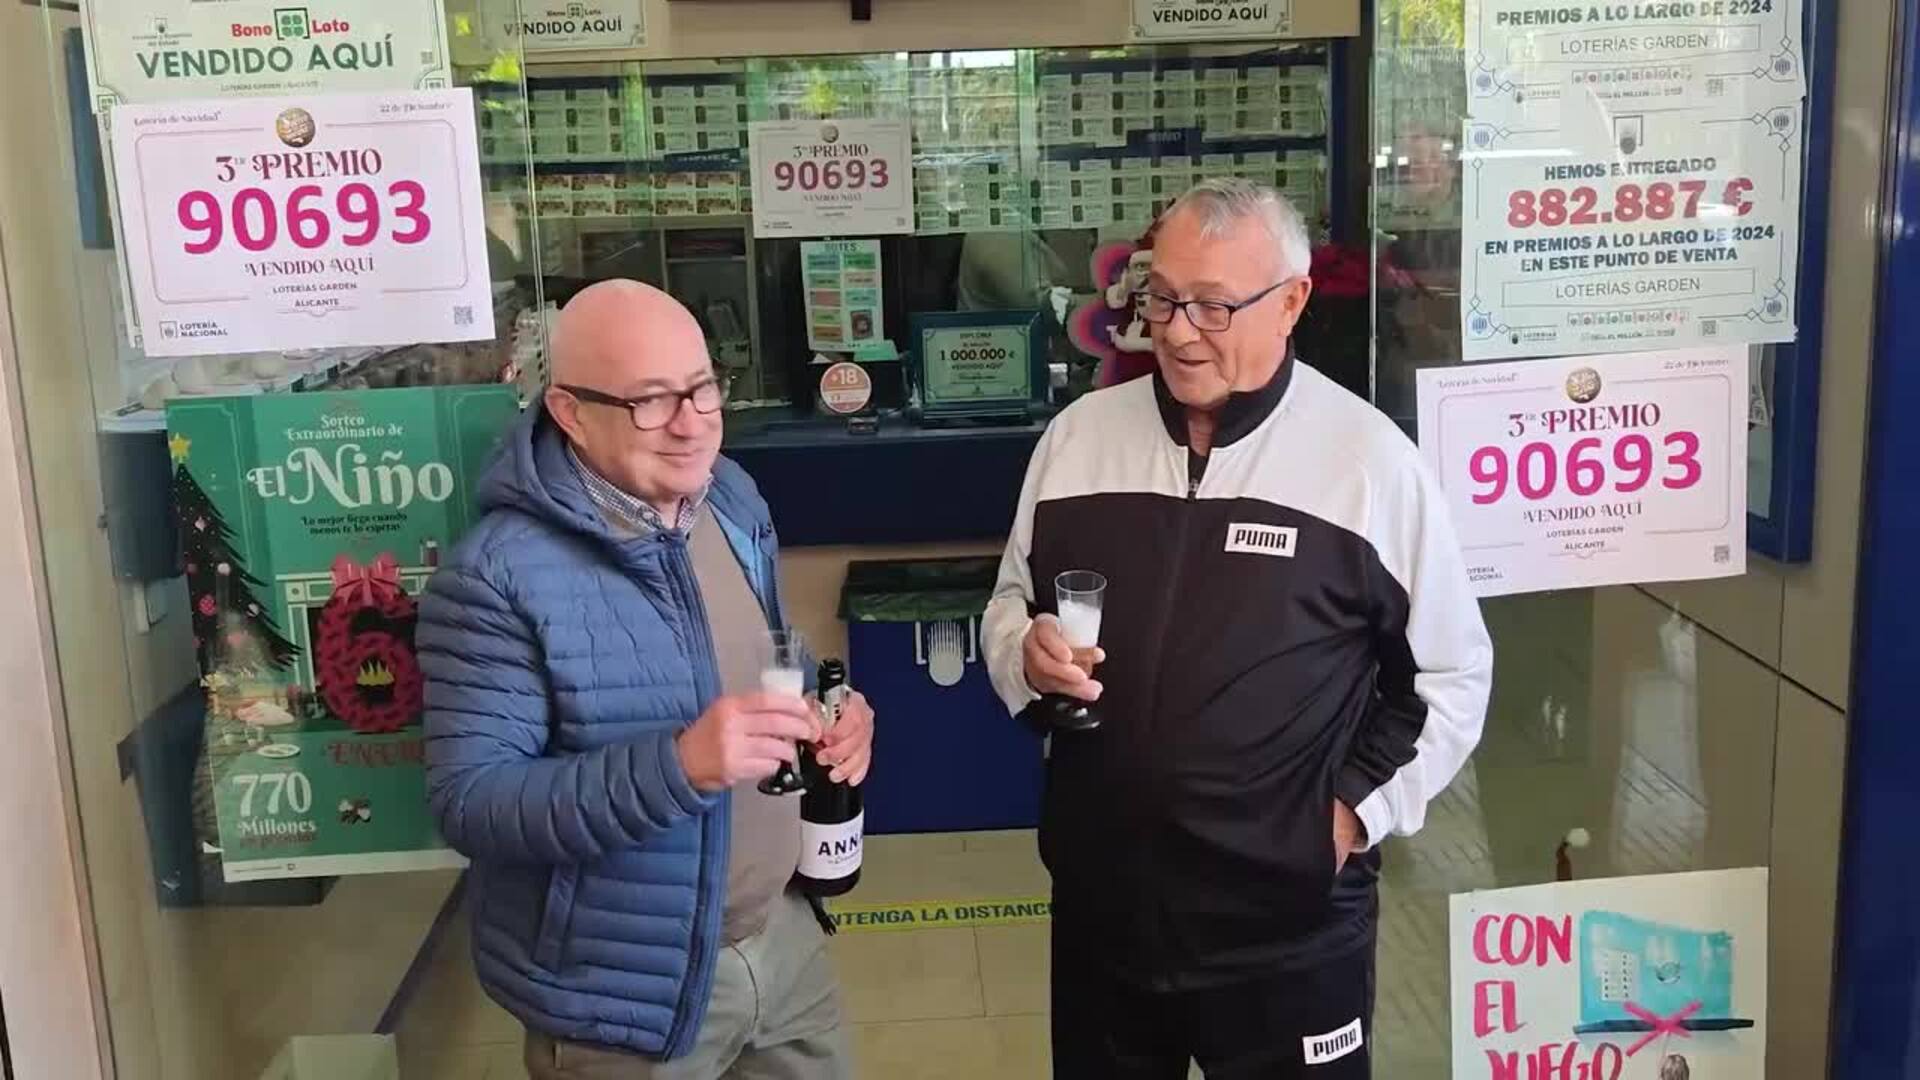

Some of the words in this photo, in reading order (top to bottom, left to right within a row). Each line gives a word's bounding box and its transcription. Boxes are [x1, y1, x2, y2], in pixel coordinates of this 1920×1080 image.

[581, 15, 622, 33] AQUÍ
[1152, 8, 1222, 23] VENDIDO
[1228, 4, 1267, 20] AQUÍ
[1497, 7, 1581, 26] PREMIOS
[1587, 7, 1599, 21] A
[1634, 2, 1695, 19] LARGO
[1700, 1, 1725, 16] DE
[1729, 0, 1772, 15] 2024
[231, 23, 273, 37] Bono
[311, 19, 349, 34] Loto
[136, 46, 294, 78] VENDIDO
[307, 34, 394, 71] AQUÍ
[1561, 37, 1639, 55] LOTERÍAS
[1643, 34, 1708, 51] GARDEN
[809, 144, 869, 158] PREMIO
[252, 148, 382, 180] PREMIO
[775, 158, 889, 191] 90693
[1545, 163, 1606, 180] HEMOS
[1508, 179, 1707, 228] 882.887
[1722, 177, 1754, 217] €
[177, 180, 431, 255] 90693
[1485, 240, 1508, 255] EN
[1513, 235, 1591, 253] PREMIOS
[1596, 234, 1608, 249] A
[1613, 232, 1634, 248] LO
[1639, 229, 1698, 246] LARGO
[1704, 228, 1727, 243] DE
[1731, 224, 1775, 241] 2024
[244, 260, 325, 278] VENDIDO
[330, 254, 374, 275] AQUÍ
[1521, 257, 1543, 273] EN
[1549, 255, 1588, 271] ESTE
[1594, 251, 1649, 268] PUNTO
[1655, 249, 1678, 265] DE
[1682, 246, 1738, 264] VENTA
[319, 282, 357, 292] GARDEN
[1556, 280, 1630, 299] LOTERÍAS
[1634, 277, 1701, 294] GARDEN
[294, 298, 339, 308] ALICANTE
[181, 328, 228, 338] NACIONAL
[321, 414, 365, 429] Sorteo
[1541, 402, 1661, 434] PREMIO
[285, 426, 385, 441] Extraordinario
[388, 424, 403, 437] de
[246, 465, 286, 498] El
[287, 443, 454, 510] Niño
[1469, 430, 1701, 505] 90693
[1524, 505, 1595, 524] VENDIDO
[1600, 500, 1643, 521] AQUÍ
[1234, 529, 1287, 549] PUMA
[1564, 540, 1605, 550] ALICANTE
[1466, 566, 1495, 575] OTERÍA
[232, 771, 312, 818] 770
[237, 815, 317, 837] Millones
[818, 832, 860, 856] ANN
[828, 908, 915, 927] NTENGA
[921, 908, 948, 922] LA
[1472, 912, 1573, 967] CON
[1474, 979, 1528, 1038] EL
[1313, 1027, 1357, 1057] PUMA
